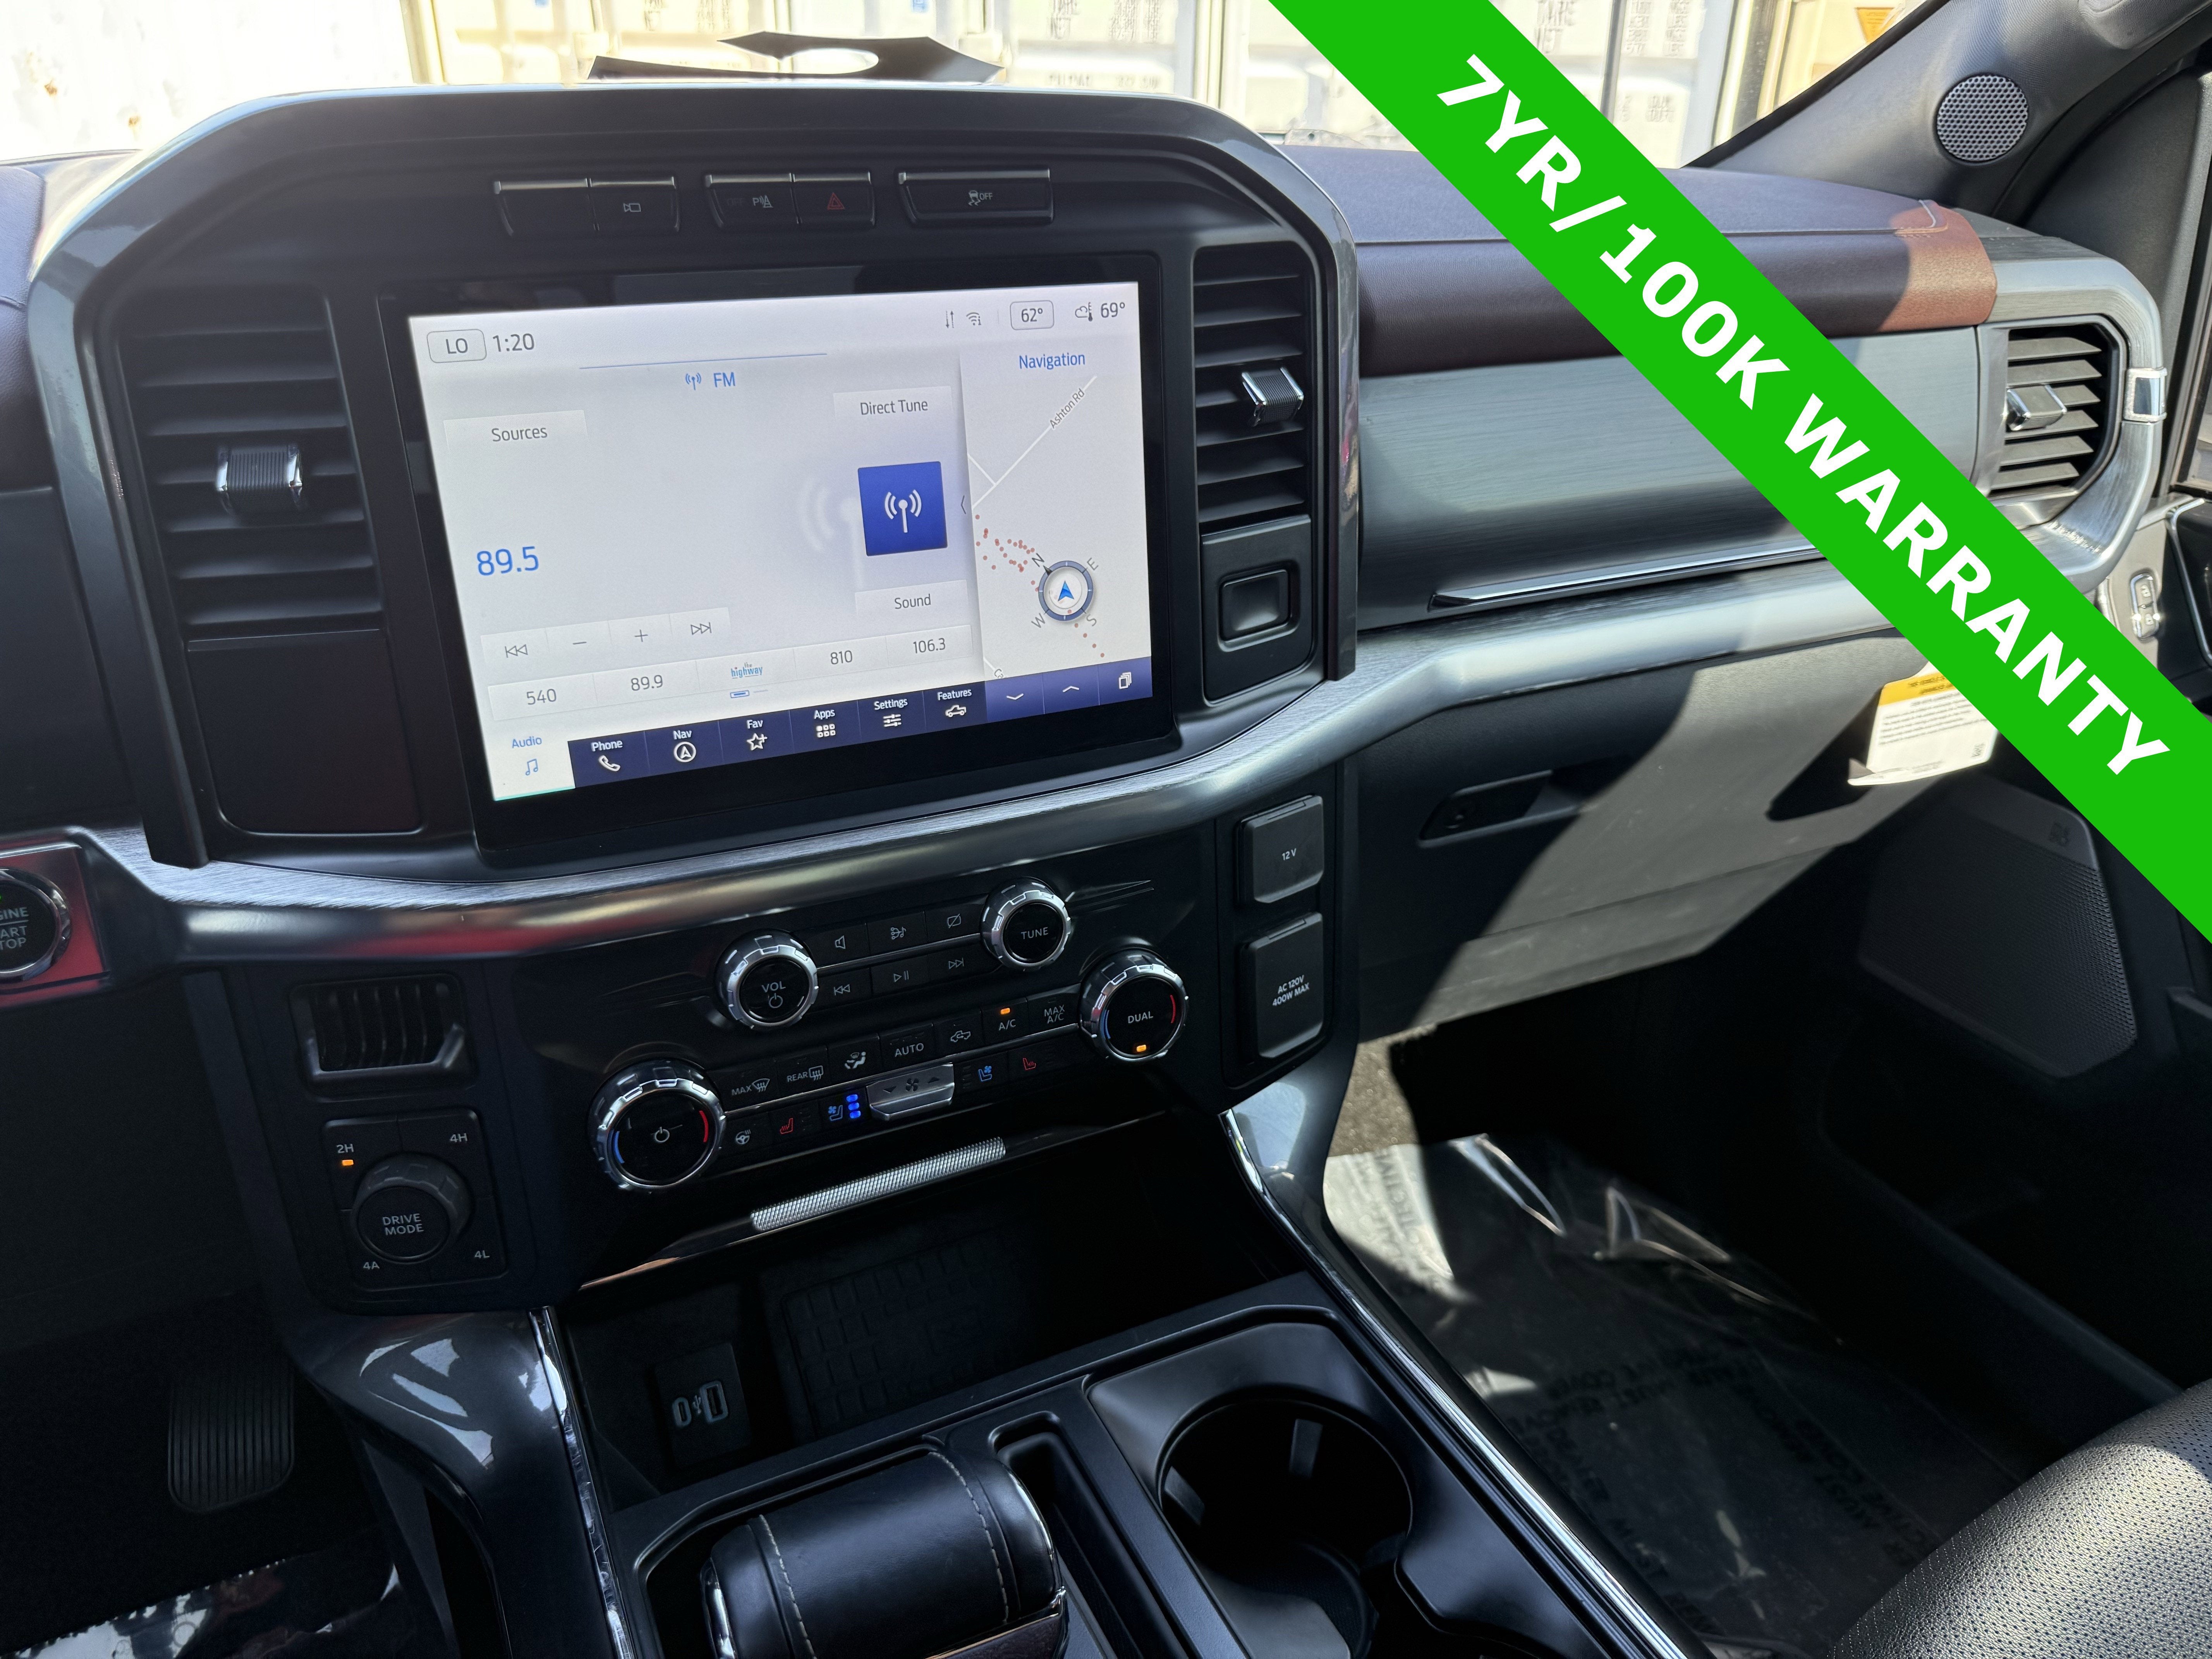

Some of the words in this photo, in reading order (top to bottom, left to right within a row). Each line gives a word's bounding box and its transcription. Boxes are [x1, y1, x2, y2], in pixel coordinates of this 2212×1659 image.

[979, 192, 993, 200] OFF
[1021, 308, 1043, 323] 62°
[1100, 302, 1125, 318] 69°
[445, 338, 468, 354] LO
[492, 333, 535, 353] 1:20
[1019, 352, 1085, 370] Navigation
[713, 372, 736, 387] FM
[860, 400, 896, 416] Direct
[898, 399, 929, 414] Tune
[1050, 400, 1075, 429] Ashton
[1072, 388, 1084, 403] Rd
[491, 425, 548, 442] Sources
[476, 546, 540, 577] 89.5
[1031, 553, 1044, 567] N
[1087, 557, 1099, 571] E
[894, 594, 931, 610] Sound
[1031, 613, 1046, 629] W
[1086, 615, 1097, 627] S
[912, 637, 946, 654] 106.3
[830, 649, 854, 665] 810
[731, 666, 763, 678] highway
[630, 675, 663, 692] 89.9
[526, 688, 557, 706] 540
[937, 688, 972, 701] Features
[874, 697, 908, 711] Settings
[814, 708, 836, 721] Apps
[746, 718, 764, 730] Fav
[673, 728, 692, 740] Nav
[512, 735, 543, 749] Audio
[591, 738, 623, 752] Phone
[1282, 851, 1290, 861] 12
[1020, 927, 1049, 940] TUNE
[761, 981, 786, 993] VOL
[1278, 983, 1288, 994] AC
[1288, 974, 1304, 989] 120V
[1273, 990, 1293, 1006] 400W
[1294, 982, 1310, 996] MAX
[1044, 1005, 1065, 1017] MAX
[1047, 1012, 1065, 1024] A/C
[1127, 1010, 1154, 1024] DUAL
[998, 1019, 1017, 1032] A/C
[894, 1042, 924, 1057] AUTO
[786, 1071, 808, 1082] REAR
[731, 1085, 752, 1096] MAX
[449, 1132, 468, 1143] 4H
[336, 1143, 354, 1154] 2H
[382, 1213, 422, 1226] DRIVE
[384, 1223, 424, 1236] MODE
[474, 1250, 490, 1259] 4L
[363, 1261, 380, 1271] 4A
